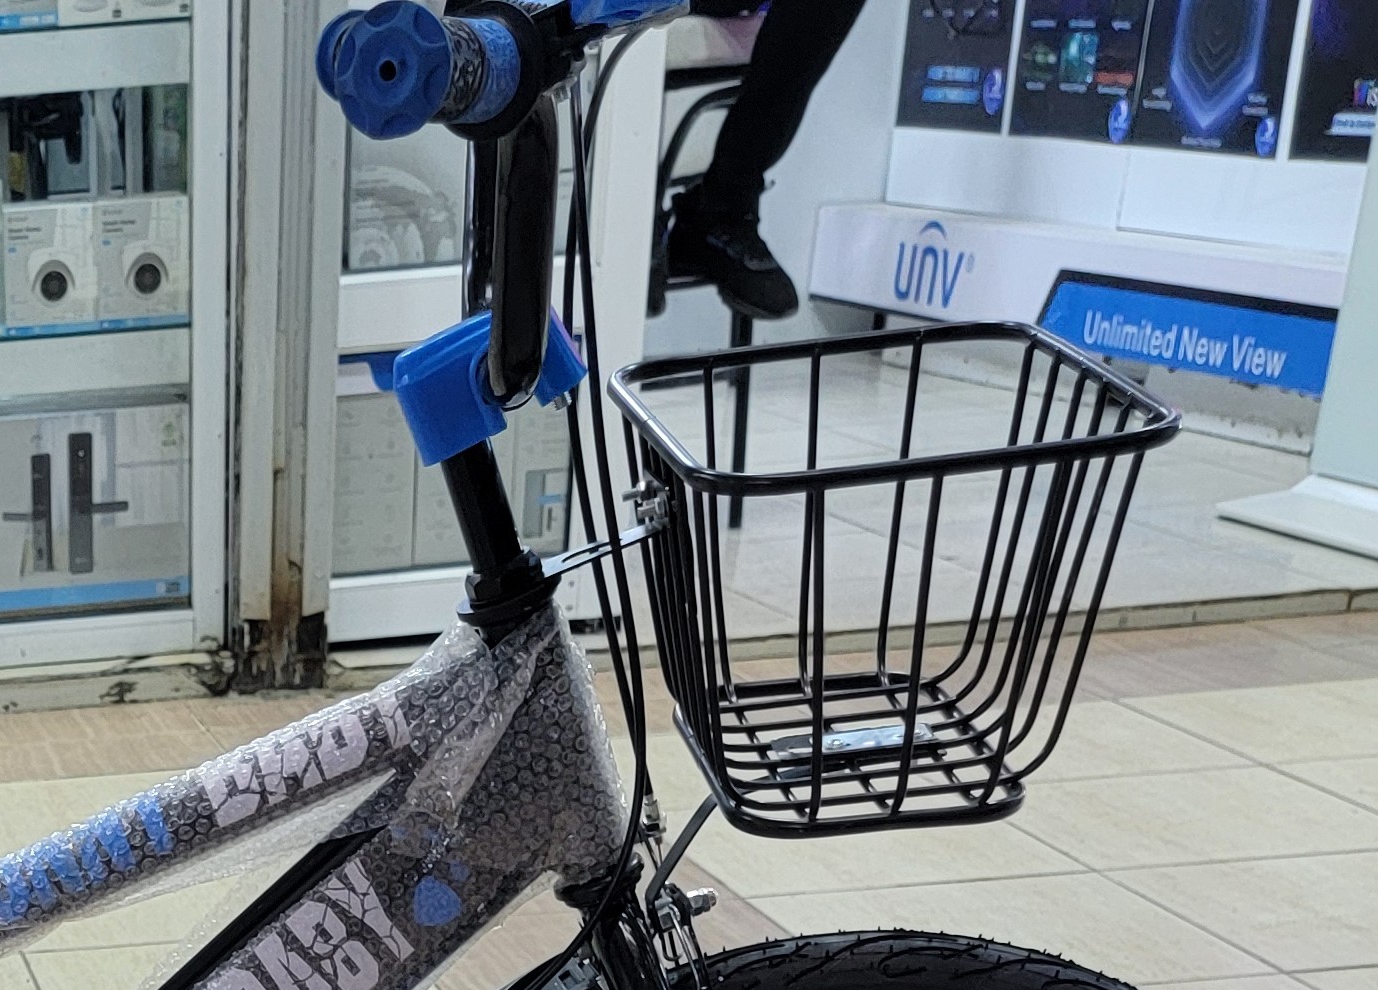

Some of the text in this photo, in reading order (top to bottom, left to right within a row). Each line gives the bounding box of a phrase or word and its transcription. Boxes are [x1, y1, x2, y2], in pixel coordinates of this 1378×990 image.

[1083, 308, 1288, 380] Unlimited New View
